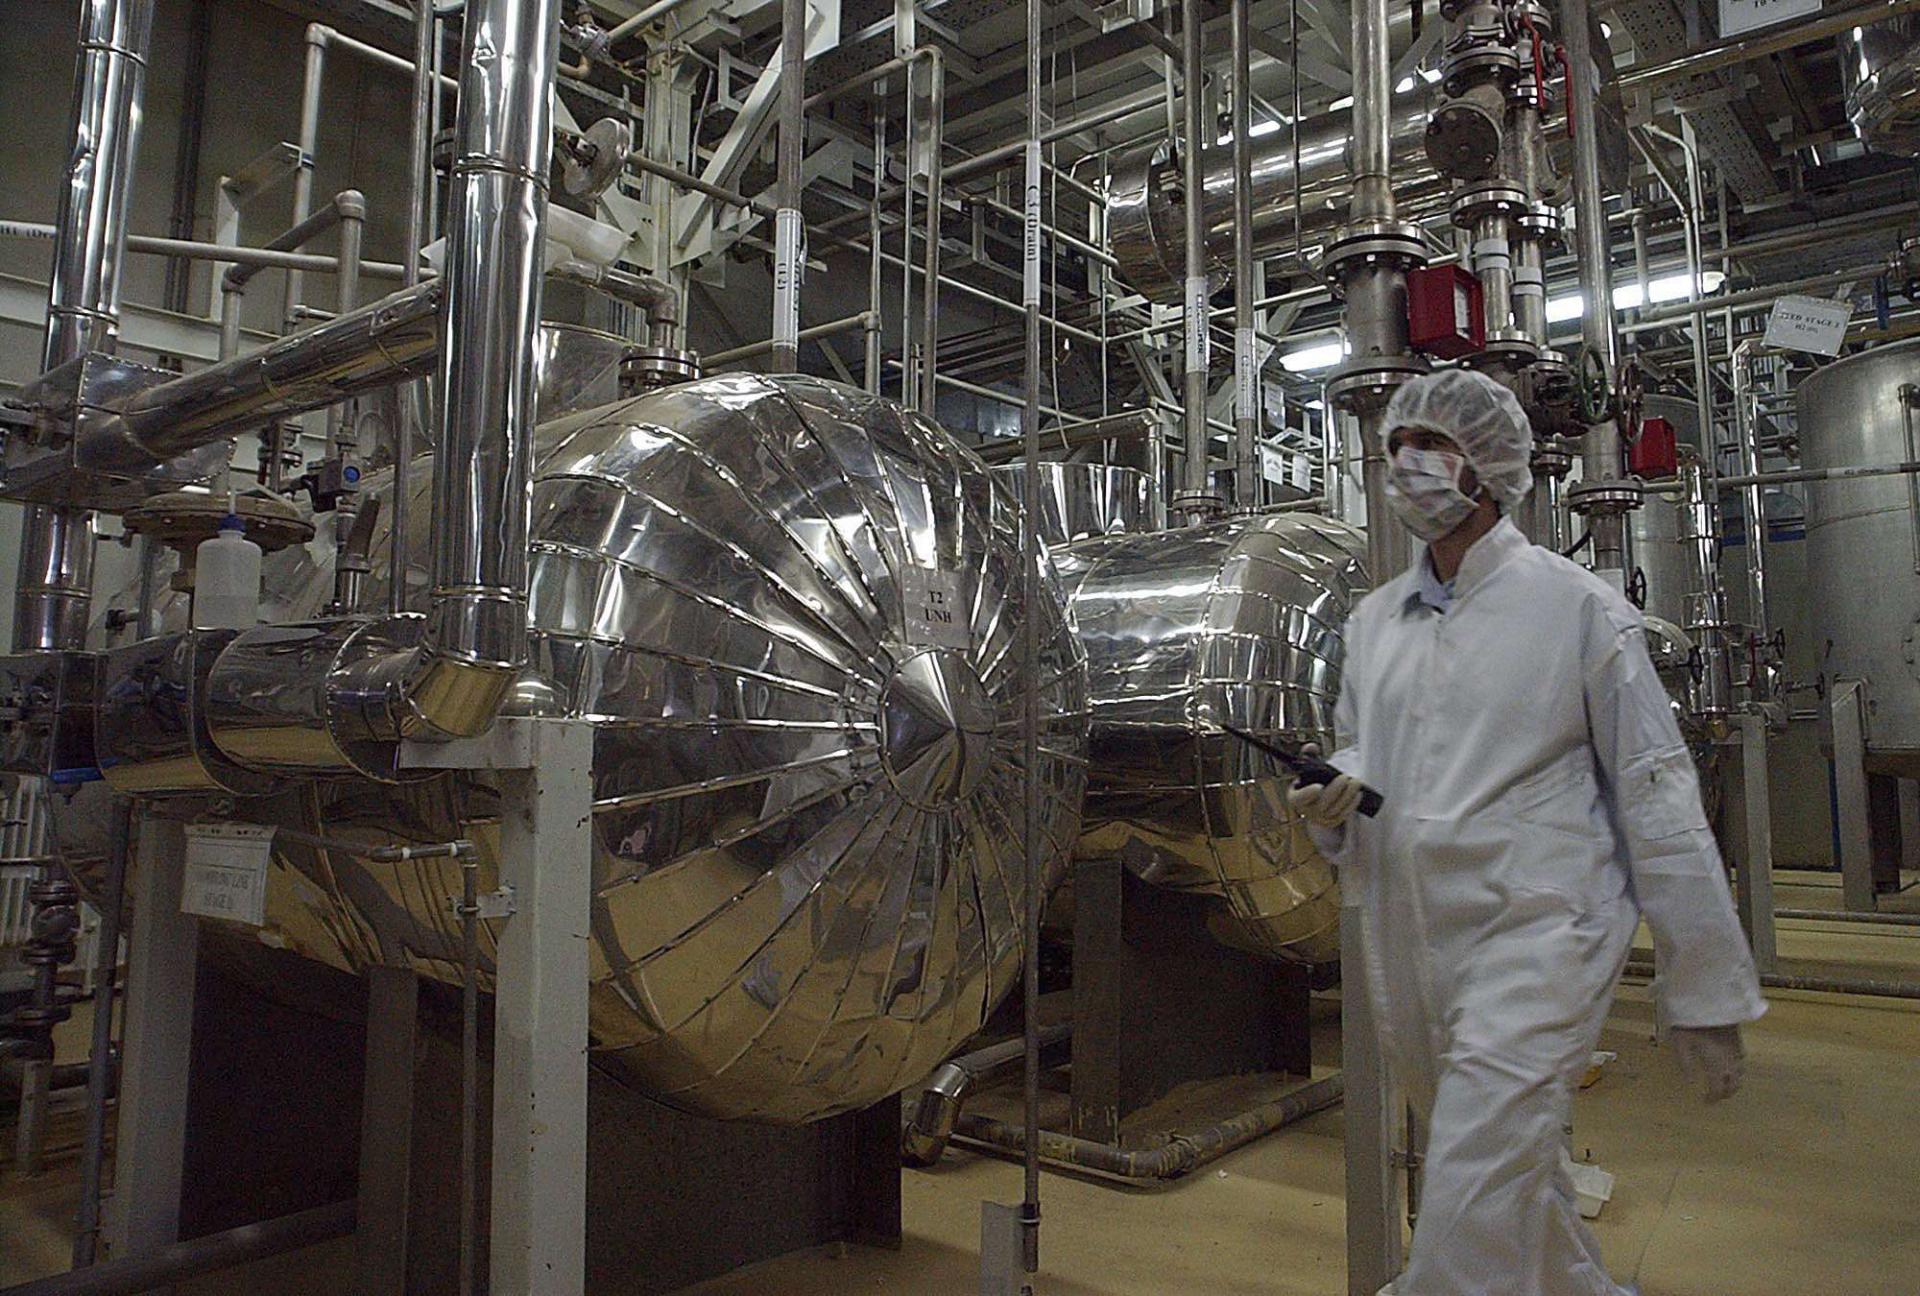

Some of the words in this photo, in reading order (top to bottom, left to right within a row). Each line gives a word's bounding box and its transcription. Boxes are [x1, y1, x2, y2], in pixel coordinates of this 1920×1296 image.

[1026, 212, 1038, 262] (Drain)
[928, 590, 944, 604] T2
[924, 608, 953, 624] UNH
